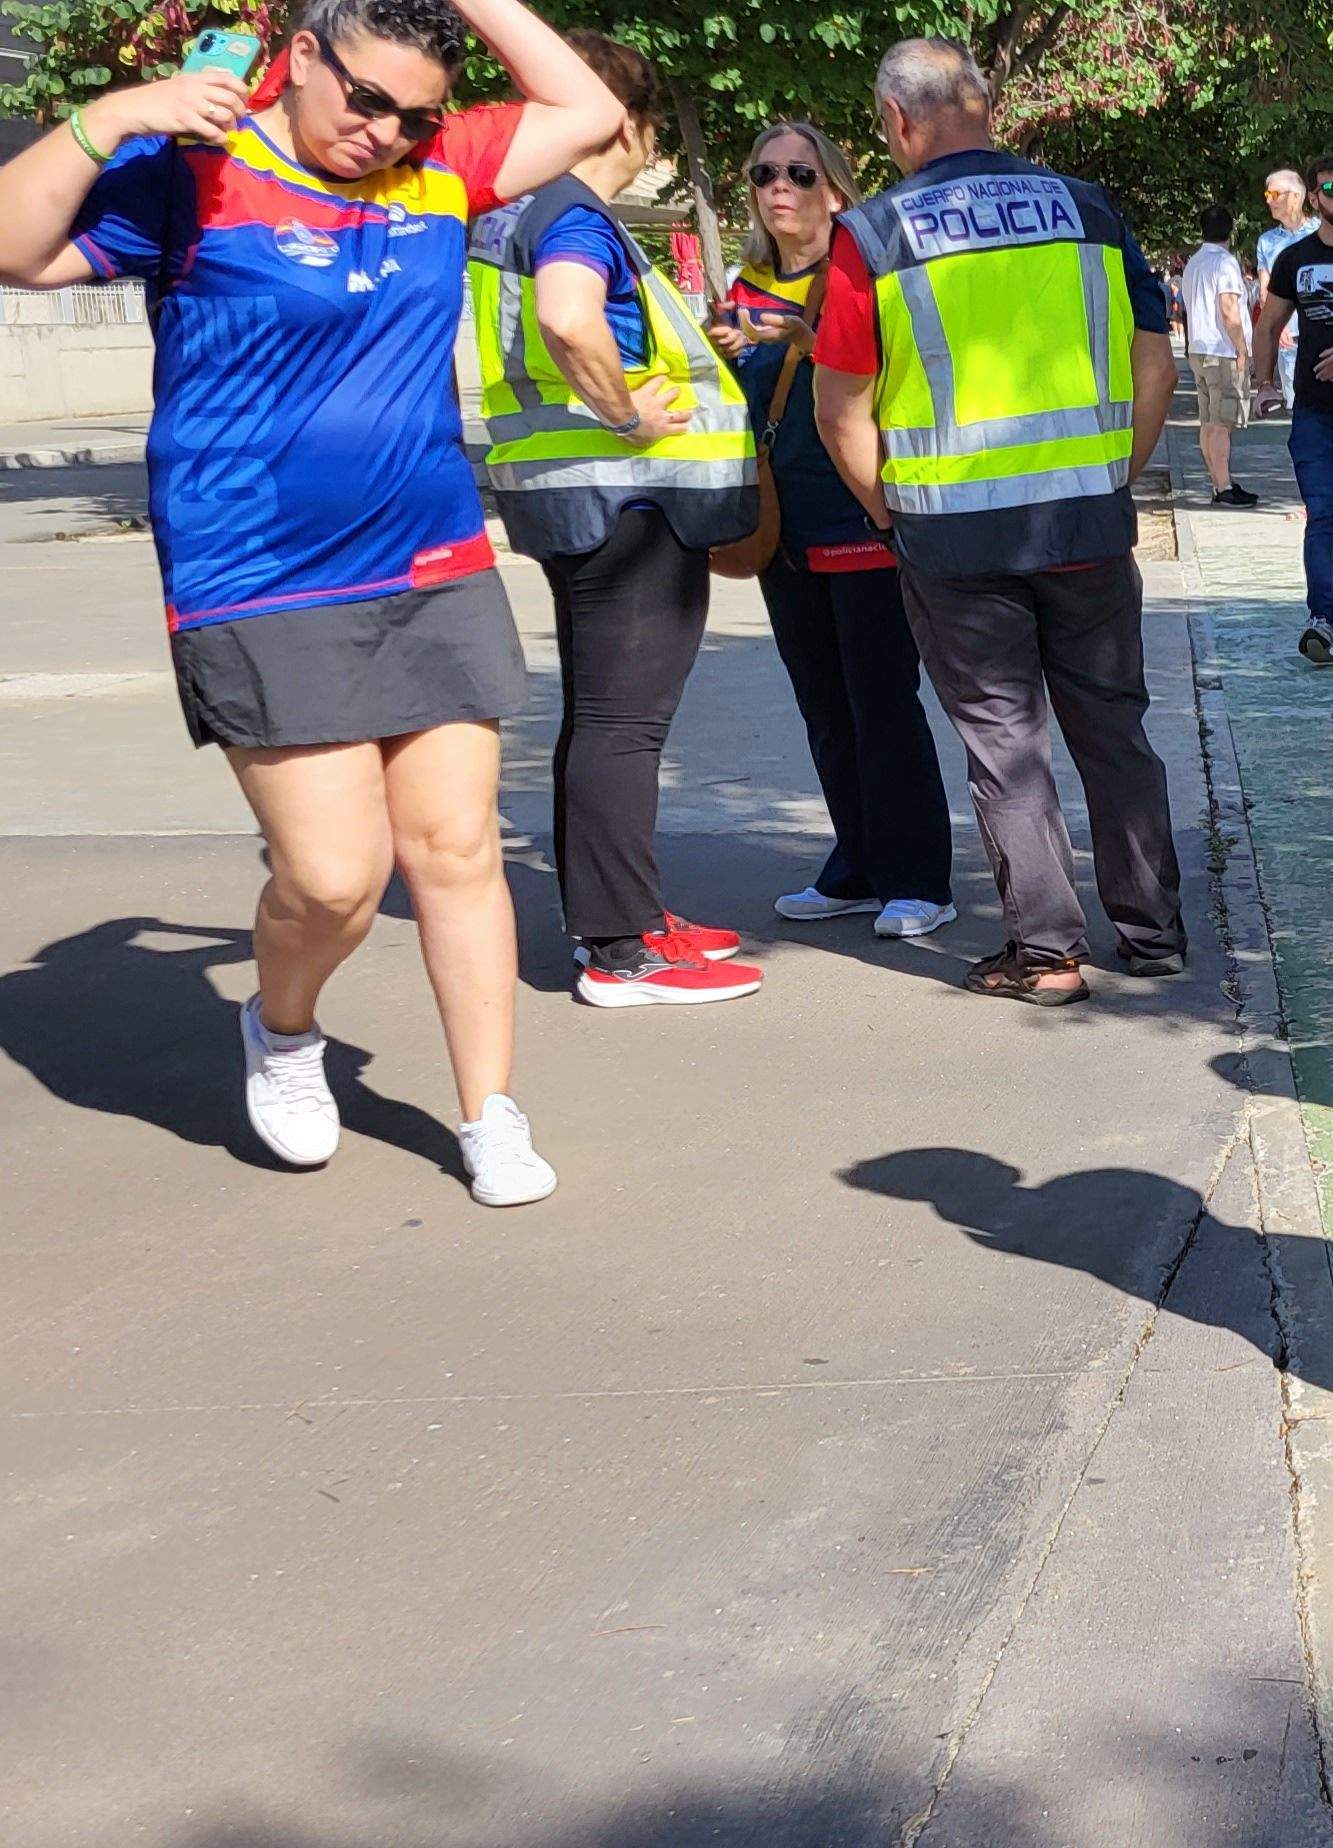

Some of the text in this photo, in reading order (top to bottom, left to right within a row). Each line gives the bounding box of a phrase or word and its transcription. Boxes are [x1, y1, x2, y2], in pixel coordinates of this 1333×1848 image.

[902, 180, 1063, 212] CUERPO NACIONAL DE
[909, 200, 1077, 249] POLICIA
